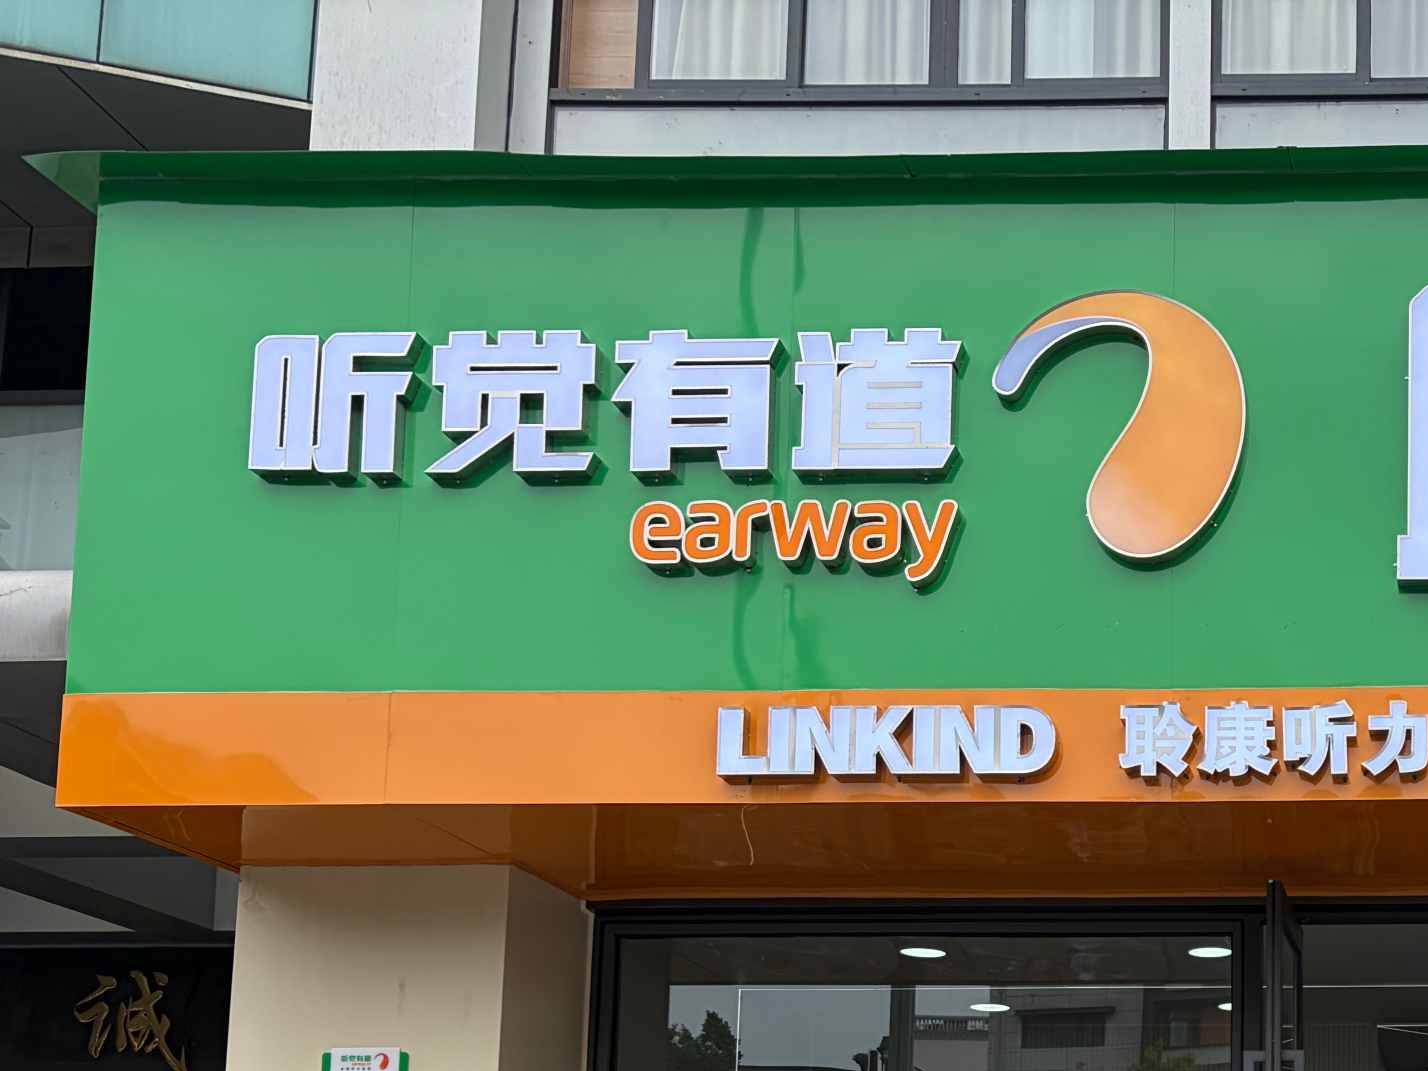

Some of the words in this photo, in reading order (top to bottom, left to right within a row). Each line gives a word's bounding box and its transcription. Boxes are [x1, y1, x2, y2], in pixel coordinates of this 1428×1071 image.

[249, 328, 962, 477] 听觉有道
[630, 500, 958, 582] earway
[716, 704, 1057, 776] LINKIND
